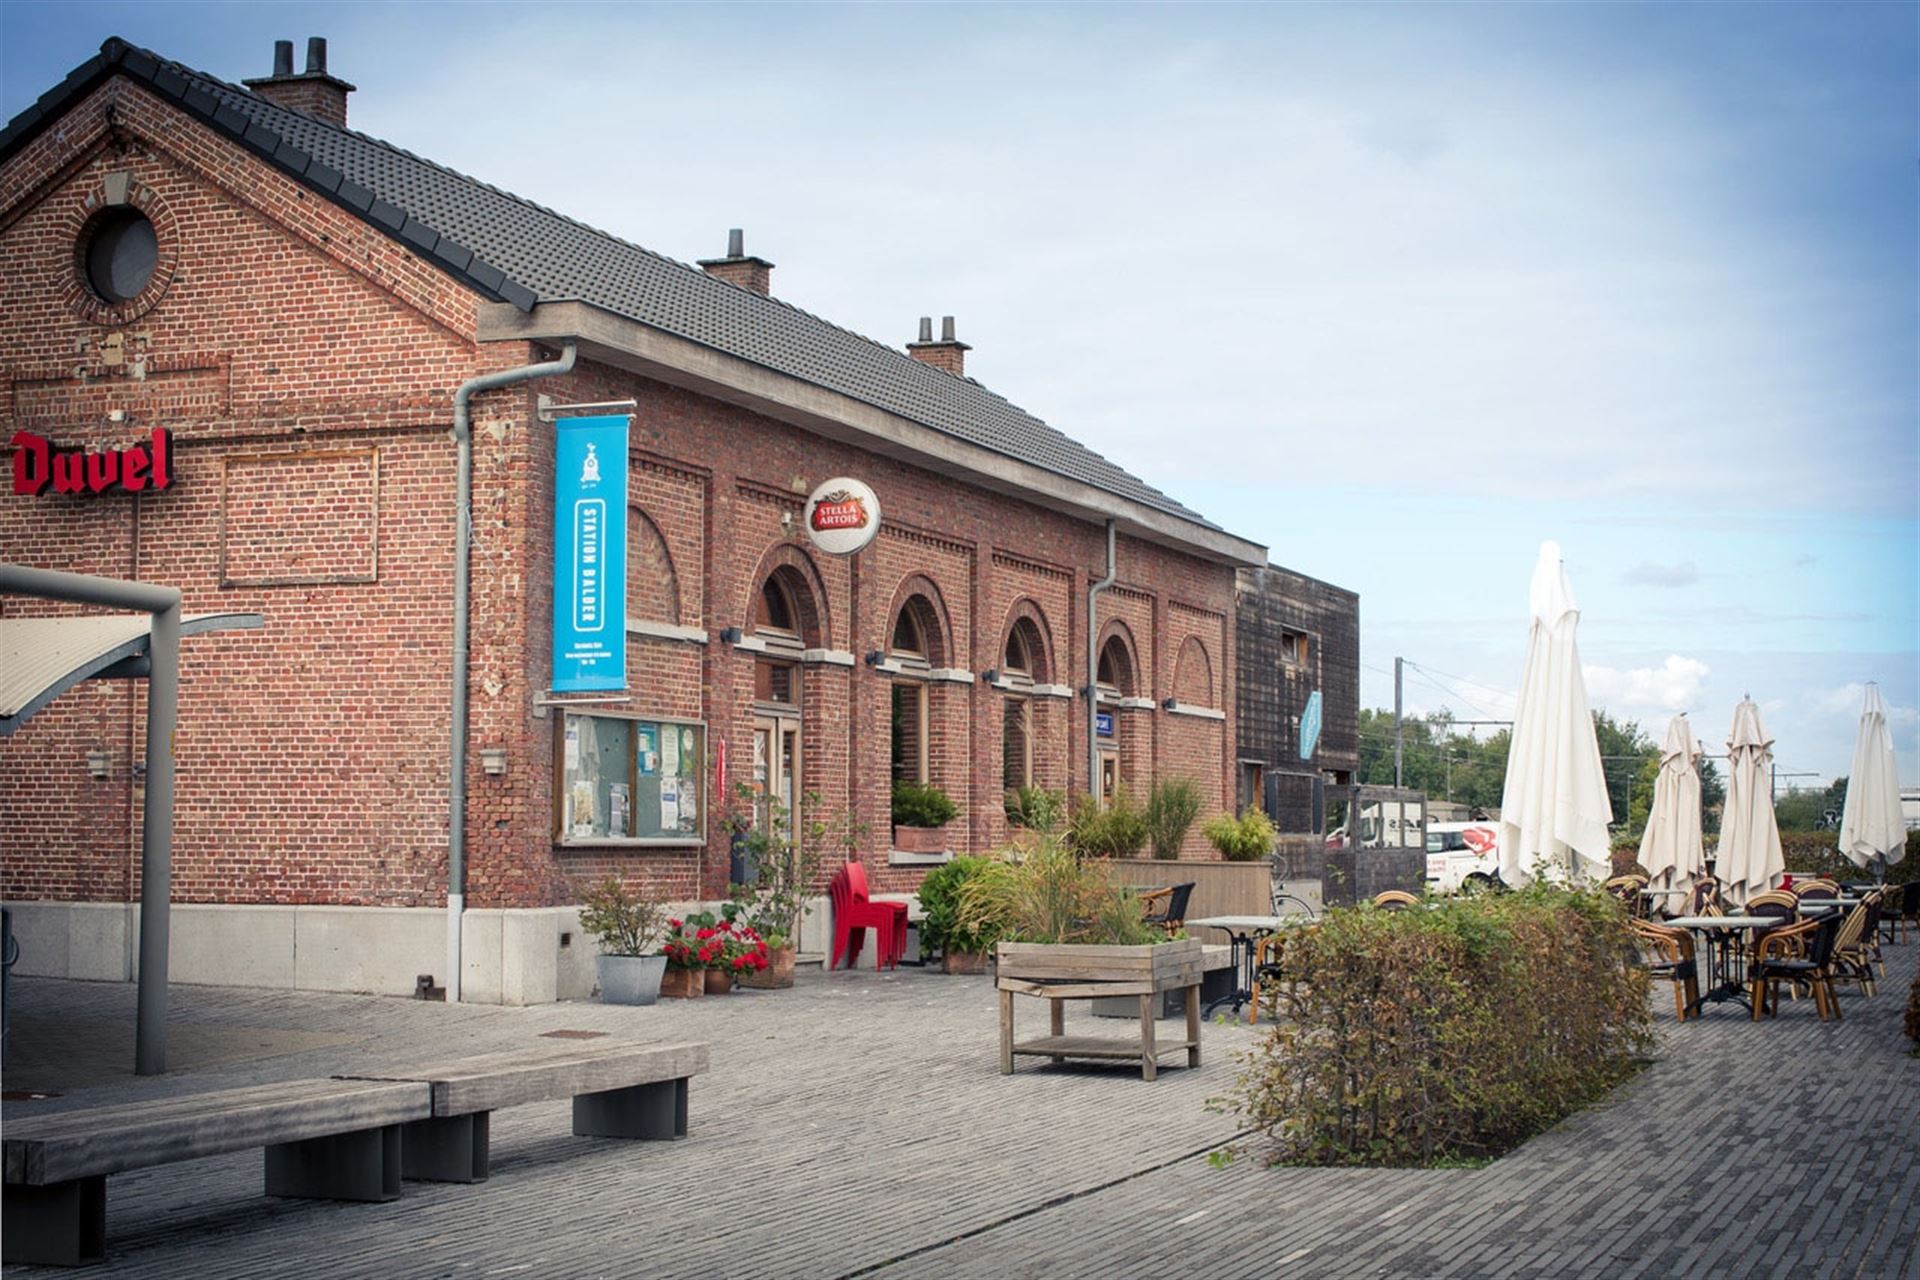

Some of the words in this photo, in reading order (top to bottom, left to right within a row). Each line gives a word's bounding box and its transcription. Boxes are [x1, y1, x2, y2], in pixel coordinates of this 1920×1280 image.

[10, 426, 170, 495] Duvel
[582, 508, 597, 563] STATION
[820, 505, 857, 515] STELLA
[820, 514, 858, 525] ARTOIS
[582, 569, 596, 621] BALDER
